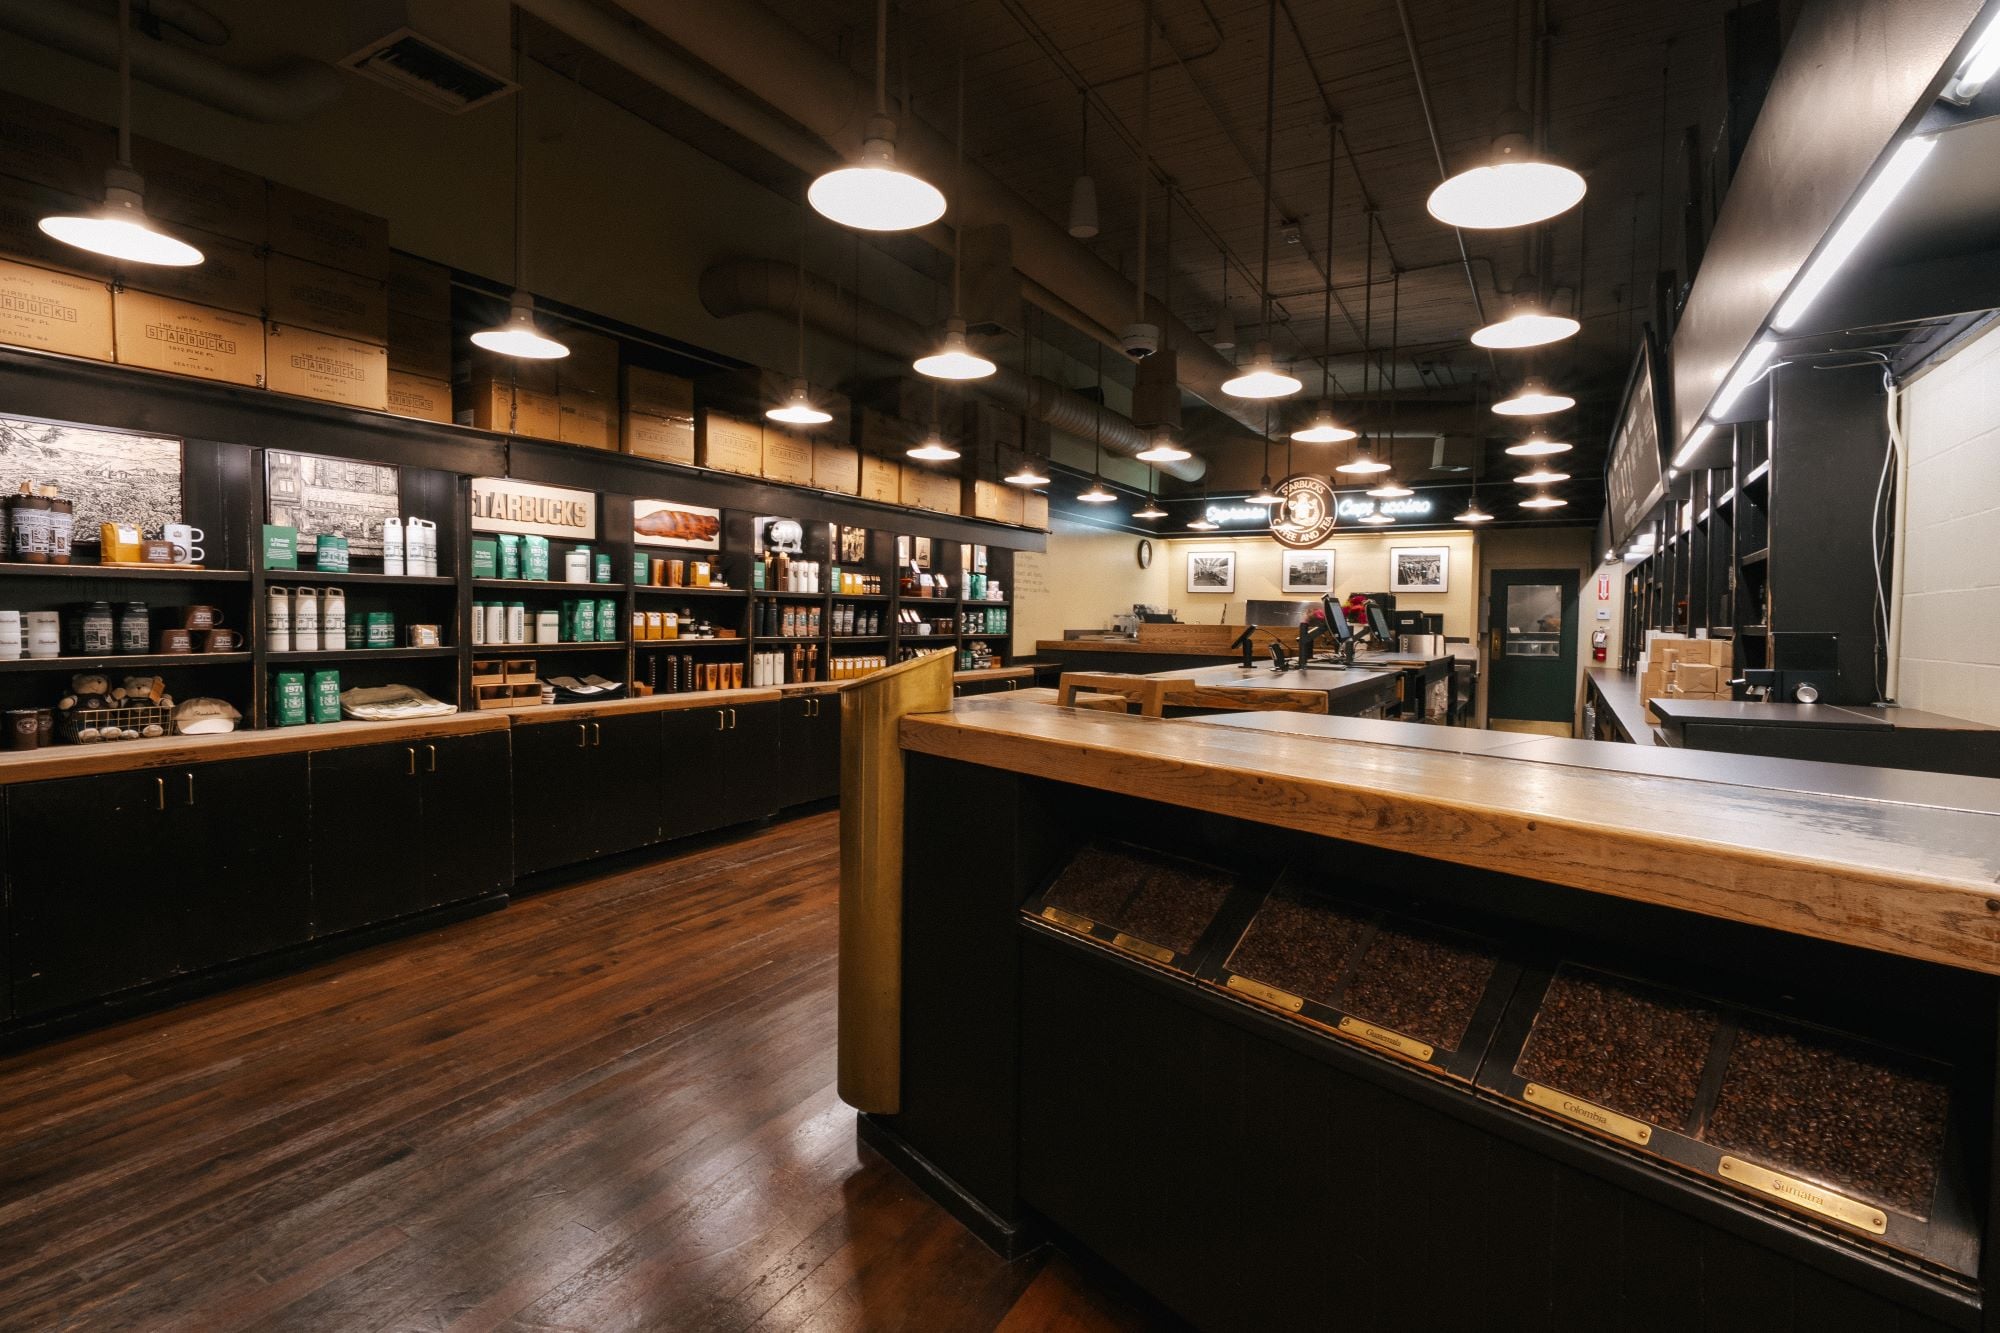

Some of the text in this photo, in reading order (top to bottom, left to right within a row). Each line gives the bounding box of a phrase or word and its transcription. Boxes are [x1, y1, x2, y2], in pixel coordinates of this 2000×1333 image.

[149, 327, 234, 352] STARBUCKS
[293, 358, 363, 379] STARBUCKS
[1300, 530, 1320, 542] AND
[1319, 516, 1334, 531] TEA
[285, 685, 303, 693] 1971
[320, 683, 338, 691] 1971
[1563, 1101, 1608, 1124] Colombia
[1772, 1178, 1825, 1206] Sumatra
